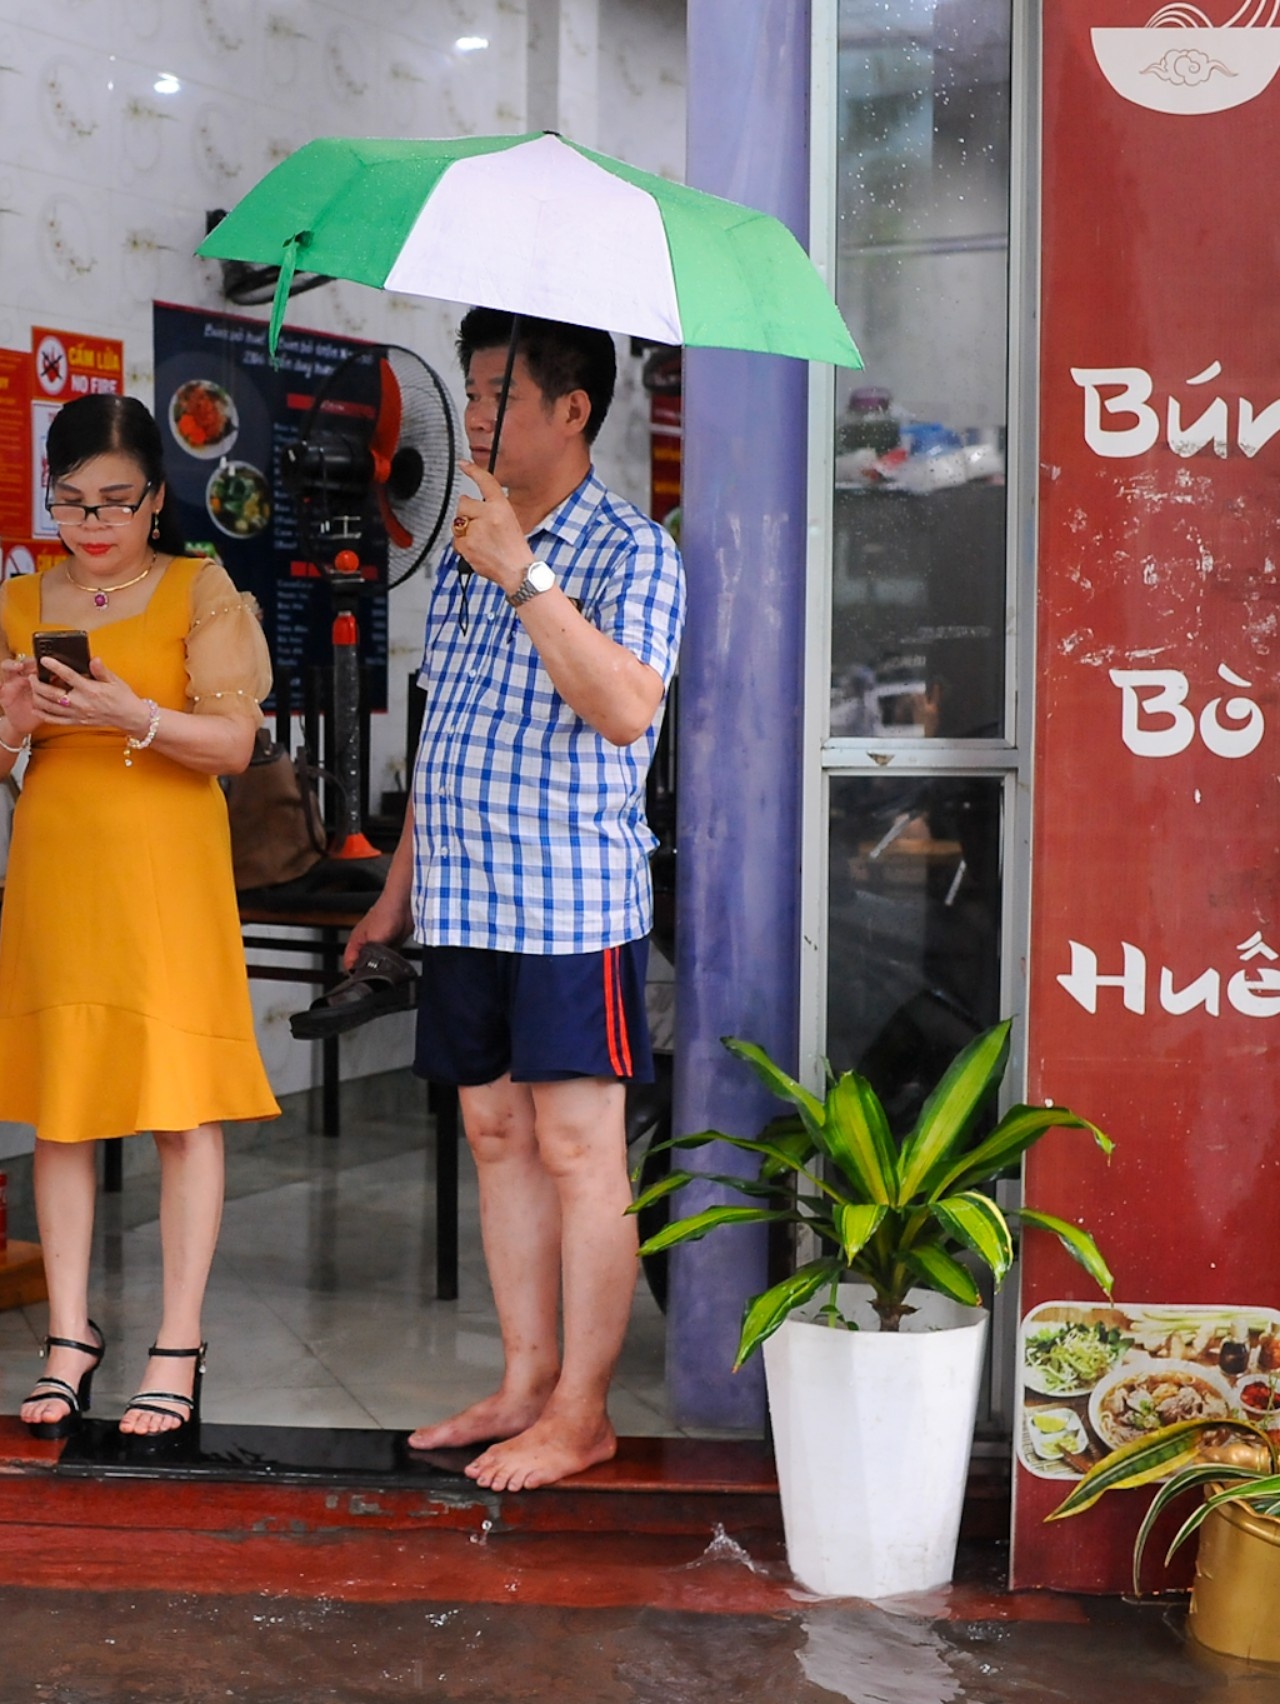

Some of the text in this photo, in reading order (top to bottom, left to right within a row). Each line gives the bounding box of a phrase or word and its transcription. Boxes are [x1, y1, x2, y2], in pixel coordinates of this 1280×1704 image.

[71, 374, 118, 395] NO FIRE
[1070, 360, 1280, 459] Bún
[1109, 664, 1264, 758] Bò
[1056, 931, 1280, 1018] Huế
